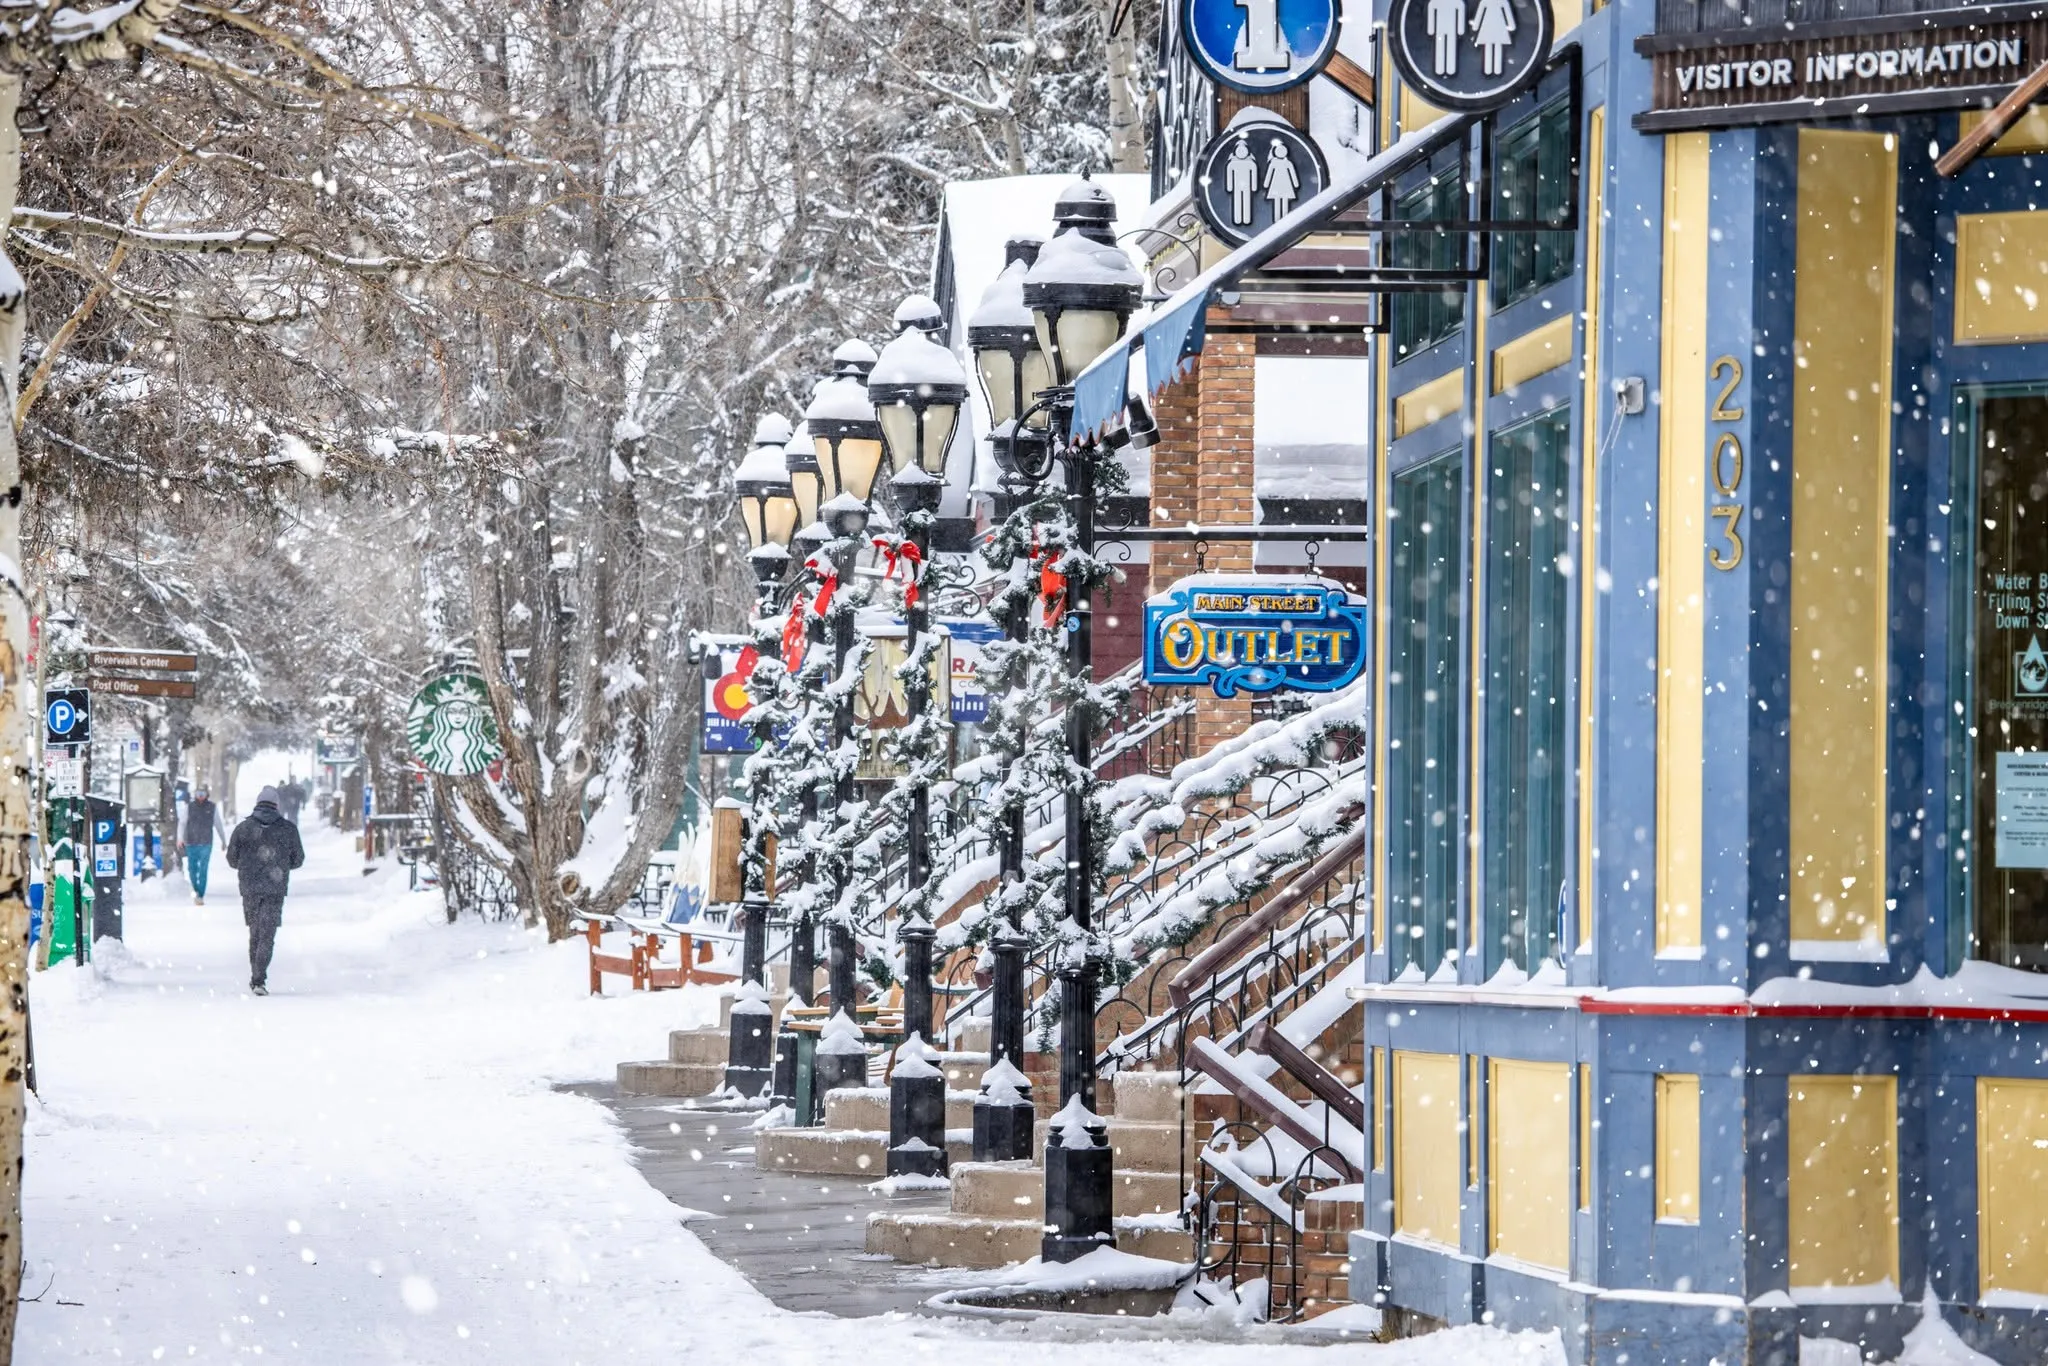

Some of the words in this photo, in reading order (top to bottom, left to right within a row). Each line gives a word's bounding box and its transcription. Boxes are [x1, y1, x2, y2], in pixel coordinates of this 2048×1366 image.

[1675, 58, 1793, 92] VISITOR
[1805, 38, 2021, 83] INFORMATION
[1709, 355, 1744, 571] 203
[1995, 574, 2032, 590] Water
[1196, 596, 1244, 611] MAIN
[1251, 596, 1317, 612] STREET
[1989, 593, 2030, 614] Filling
[1996, 613, 2029, 630] Down
[1162, 619, 1351, 671] OUTLET
[94, 655, 138, 666] Riverwalk
[140, 657, 170, 667] Center
[93, 679, 112, 690] Post
[115, 681, 140, 692] Office
[55, 706, 70, 729] P
[98, 822, 110, 839] P
